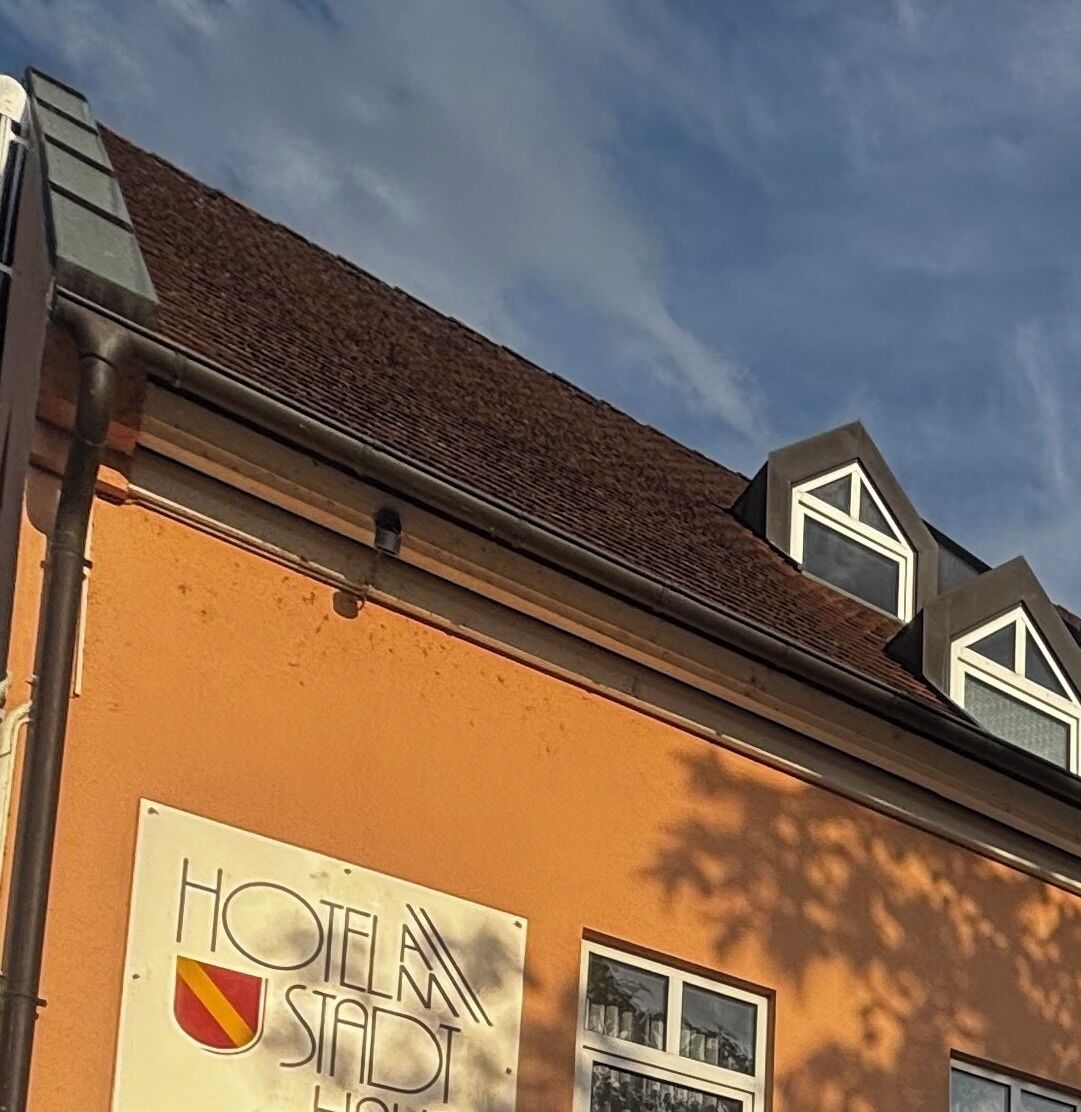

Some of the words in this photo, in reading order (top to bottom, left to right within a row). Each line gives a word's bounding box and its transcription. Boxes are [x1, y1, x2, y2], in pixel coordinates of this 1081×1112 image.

[177, 858, 392, 998] HOTEL
[398, 923, 461, 1018] AM
[280, 984, 461, 1104] STADT
